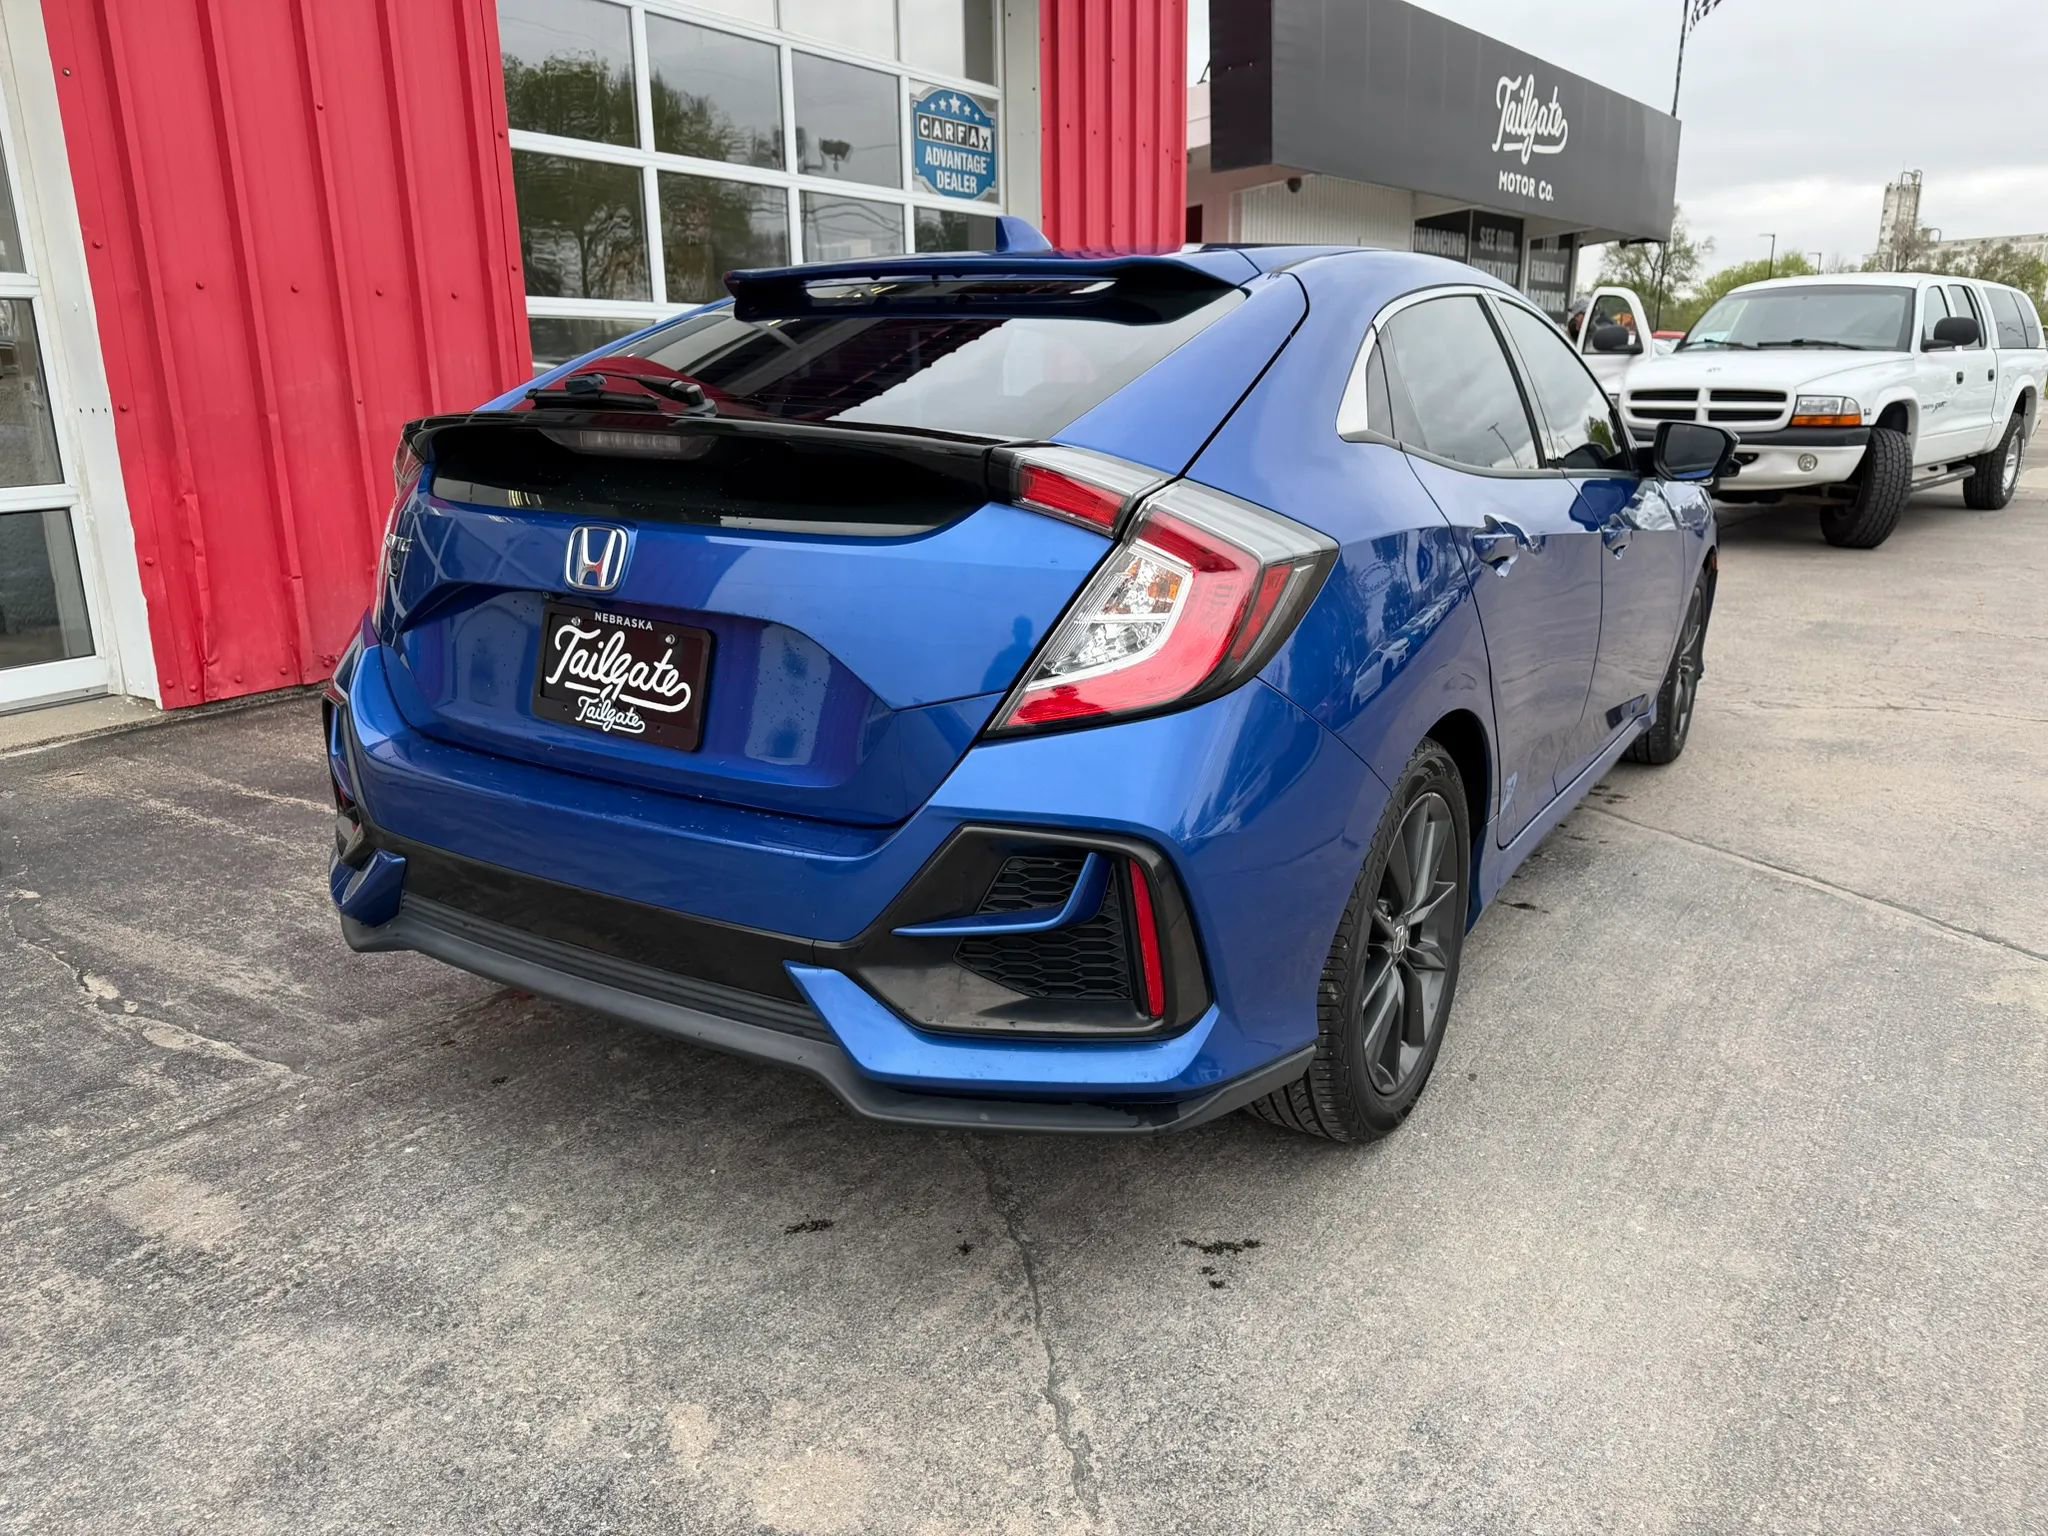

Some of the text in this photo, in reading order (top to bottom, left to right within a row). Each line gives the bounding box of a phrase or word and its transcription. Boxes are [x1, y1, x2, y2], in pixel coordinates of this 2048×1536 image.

[919, 118, 990, 152] CARFAX
[1492, 74, 1568, 165] Tailgate
[924, 146, 988, 175] ADVANTAGE
[936, 170, 978, 194] DEALER
[1498, 169, 1555, 201] MOTOR CO.
[1414, 226, 1467, 257] INANCING
[1479, 226, 1496, 251] SEE
[594, 612, 654, 631] NEBRASKA
[545, 624, 692, 713] Tailgate
[574, 695, 646, 734] Tailgate
